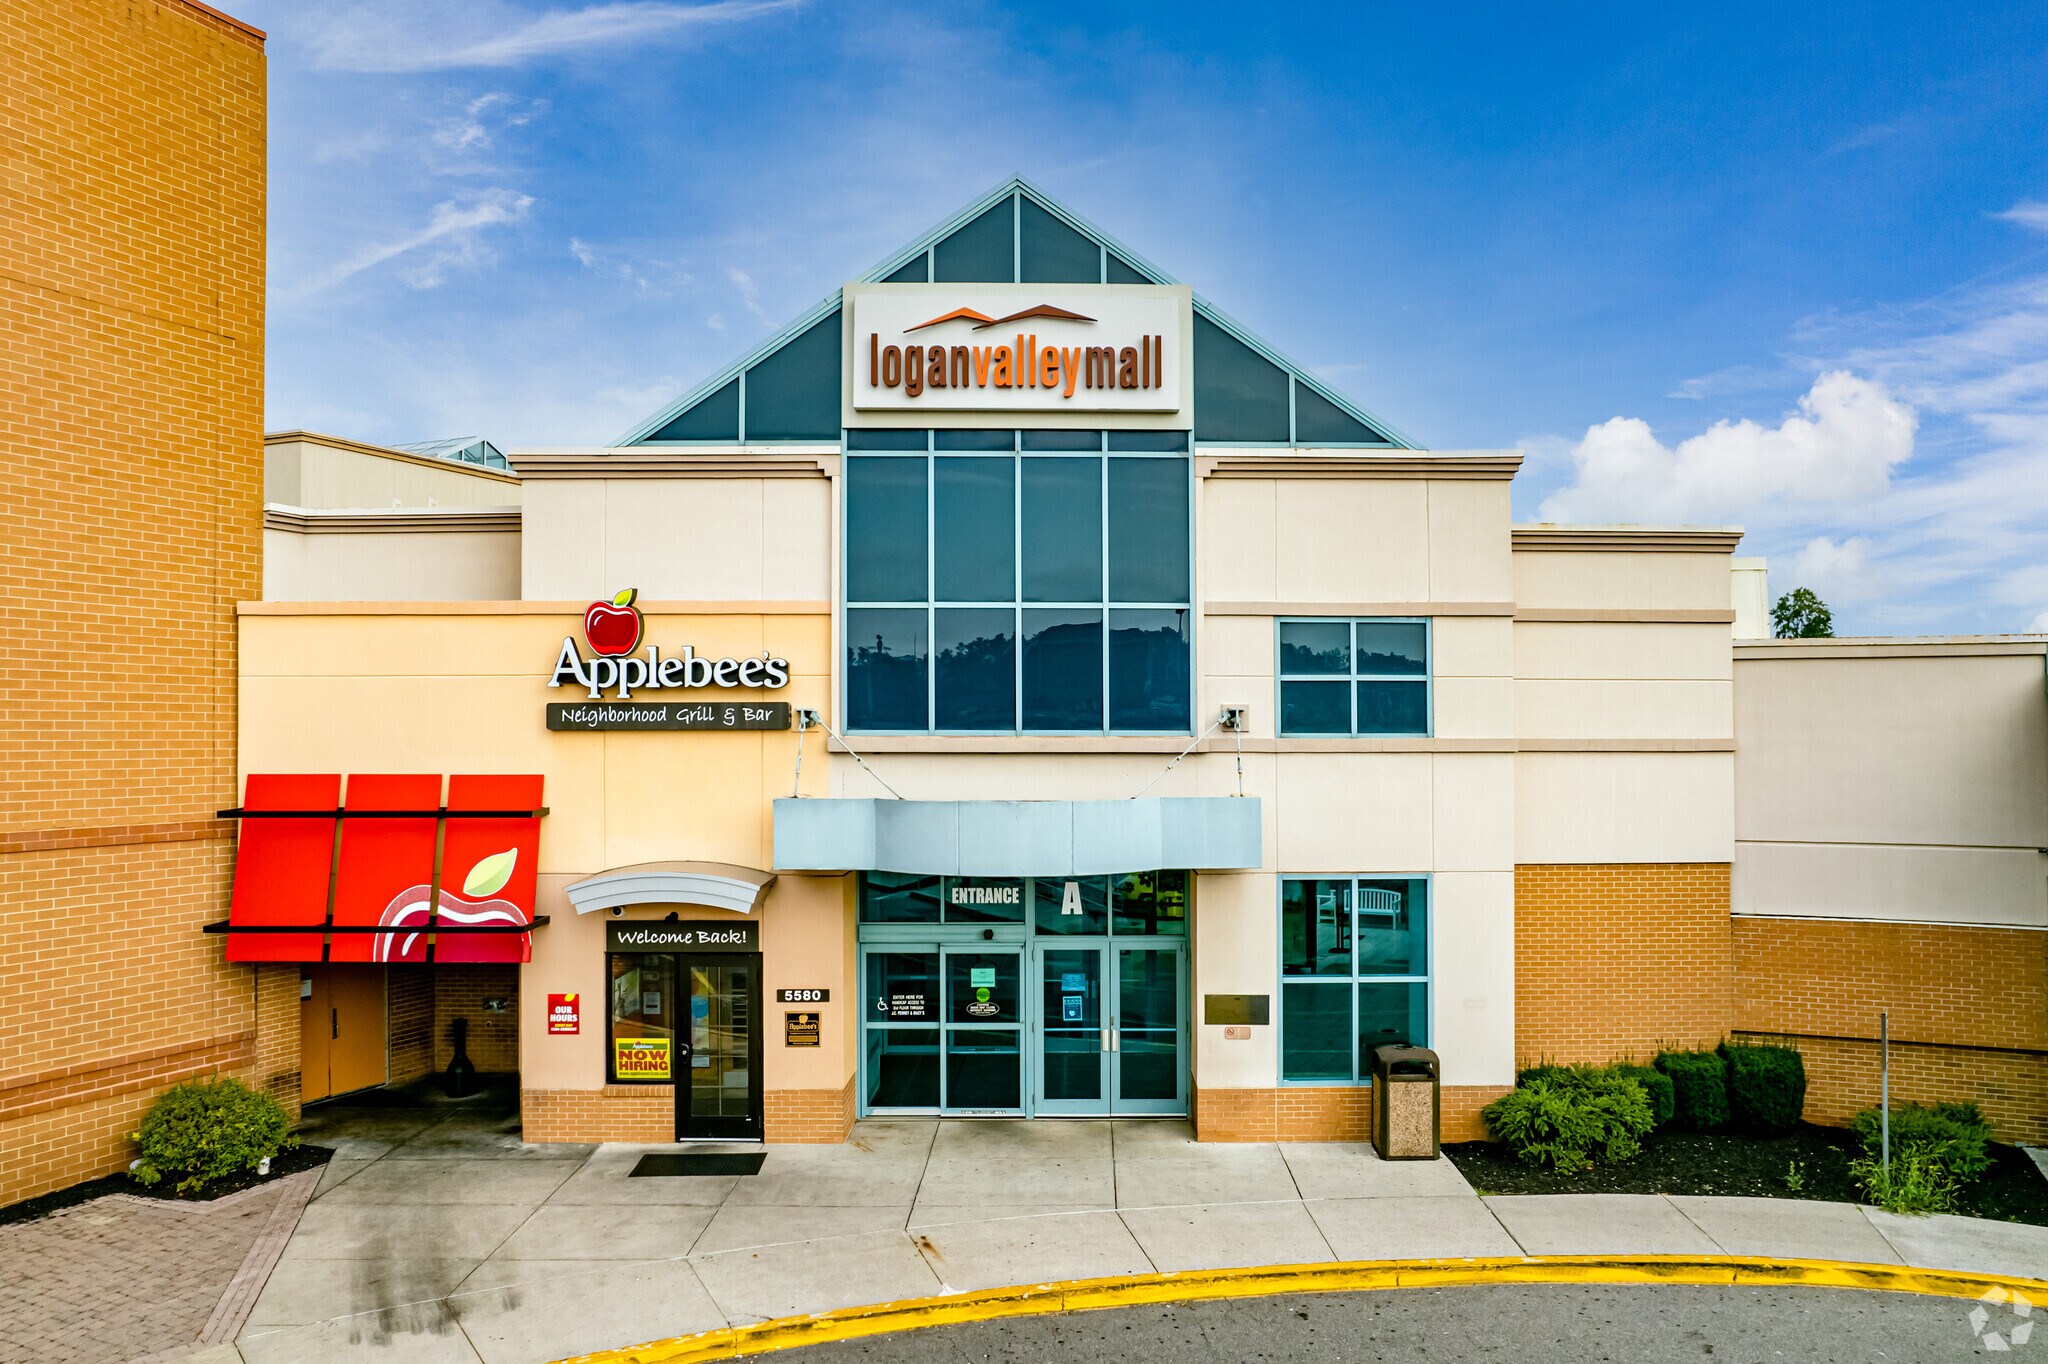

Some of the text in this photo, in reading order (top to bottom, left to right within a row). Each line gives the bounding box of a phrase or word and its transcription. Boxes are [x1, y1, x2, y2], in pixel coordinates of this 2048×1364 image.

[547, 636, 789, 698] Applebee's
[561, 706, 773, 727] Neighborhood Grill & Bar
[951, 881, 1083, 915] ENTRANCE A
[617, 929, 747, 944] Welcome Back!
[784, 990, 821, 1001] 5580
[618, 1051, 667, 1060] NOW
[619, 1061, 668, 1071] HIRING
